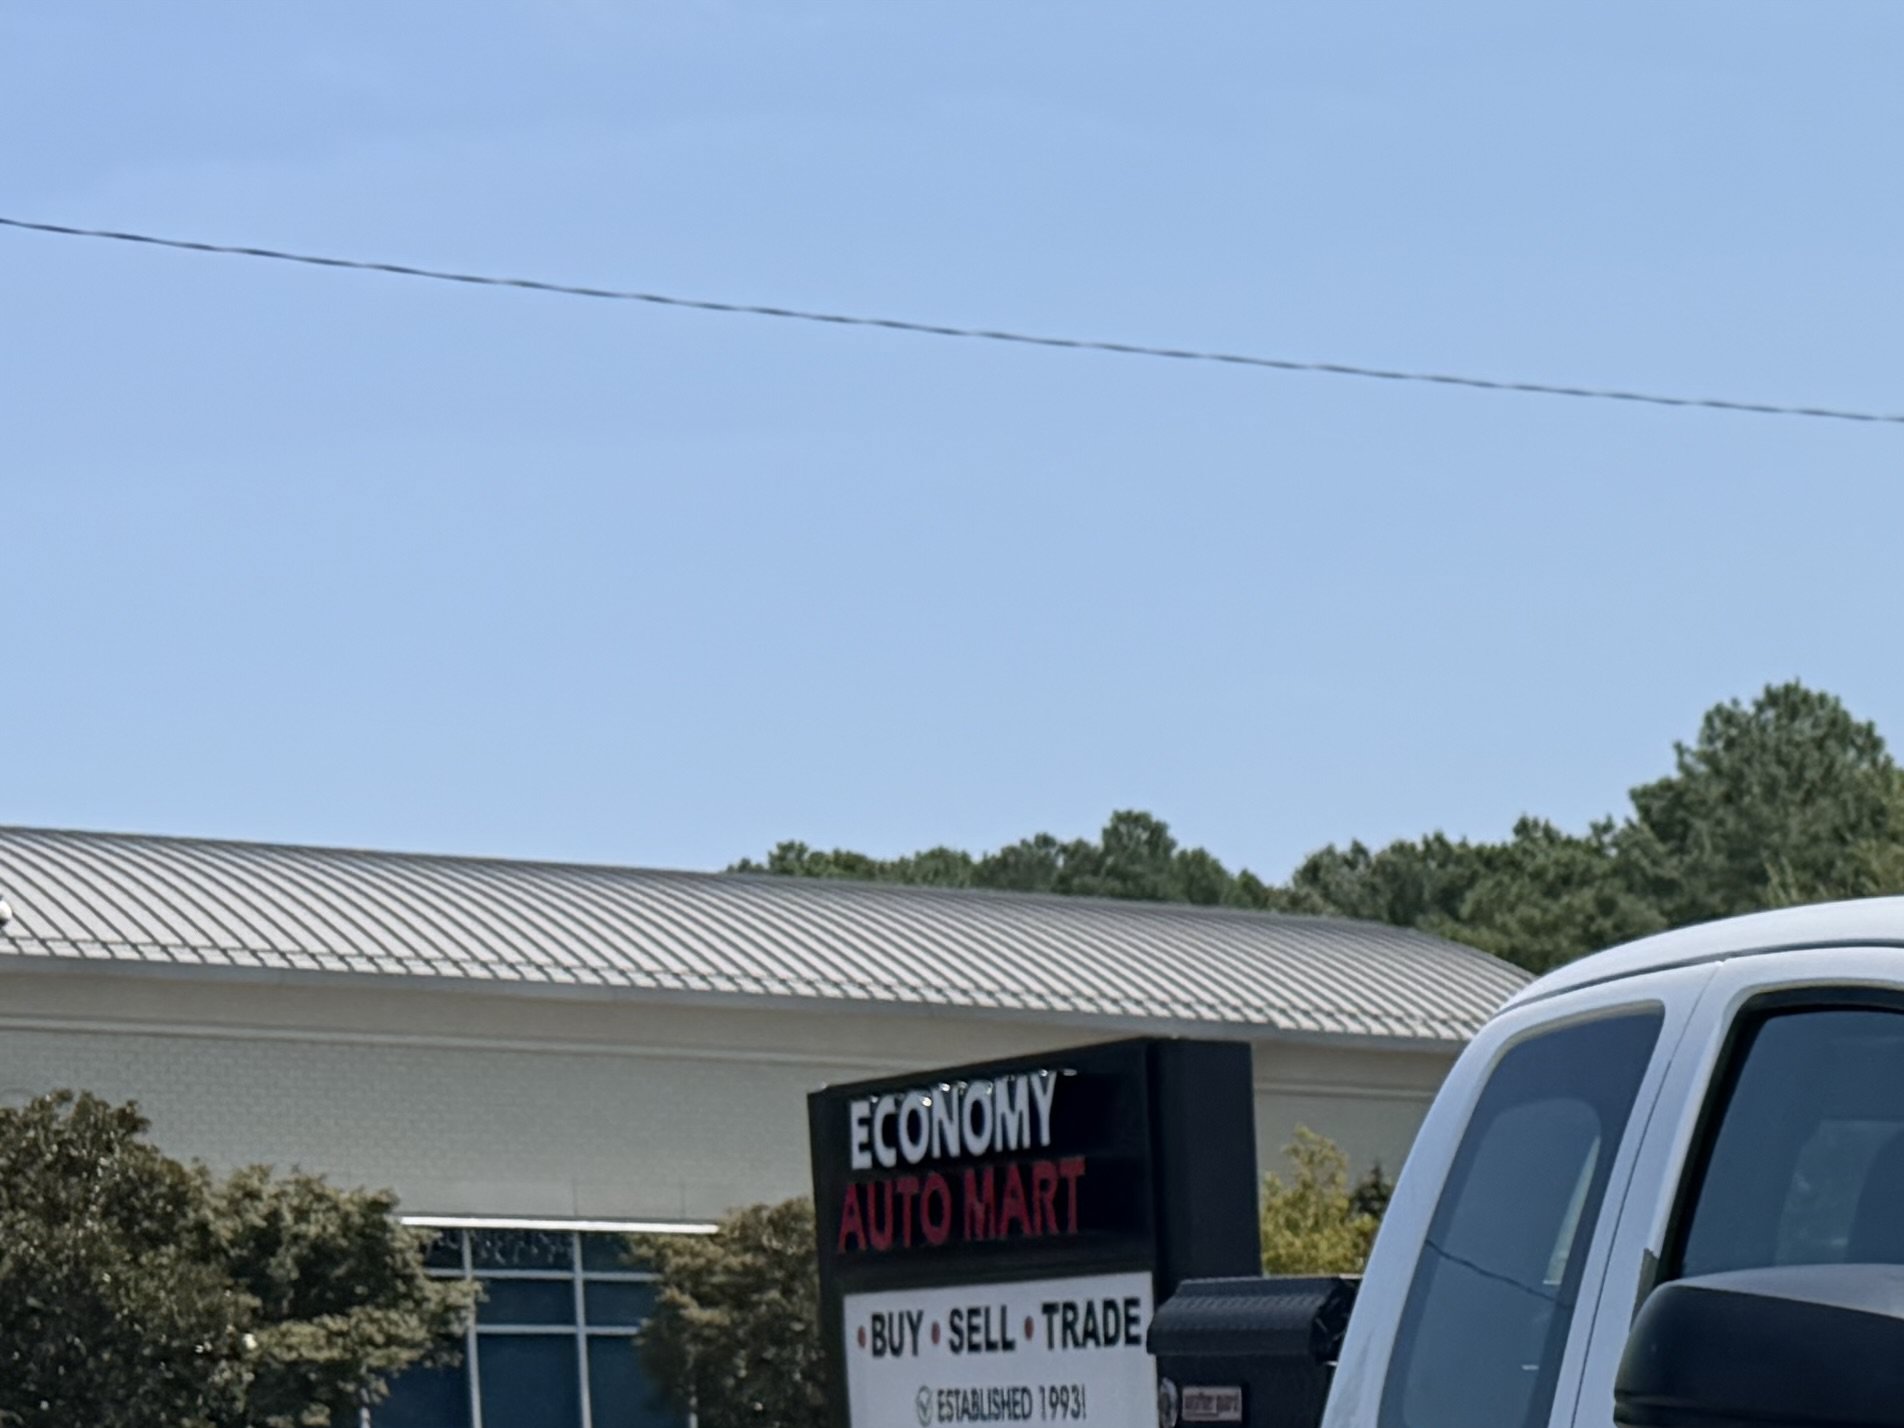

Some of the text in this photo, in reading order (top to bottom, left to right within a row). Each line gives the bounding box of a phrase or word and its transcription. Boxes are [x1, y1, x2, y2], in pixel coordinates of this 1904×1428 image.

[849, 1071, 1058, 1171] ECONOMY
[838, 1154, 1086, 1254] AUTO MART
[870, 1297, 1142, 1358] BUY SELL TRADE
[936, 1386, 1033, 1424] ESTABLISHED
